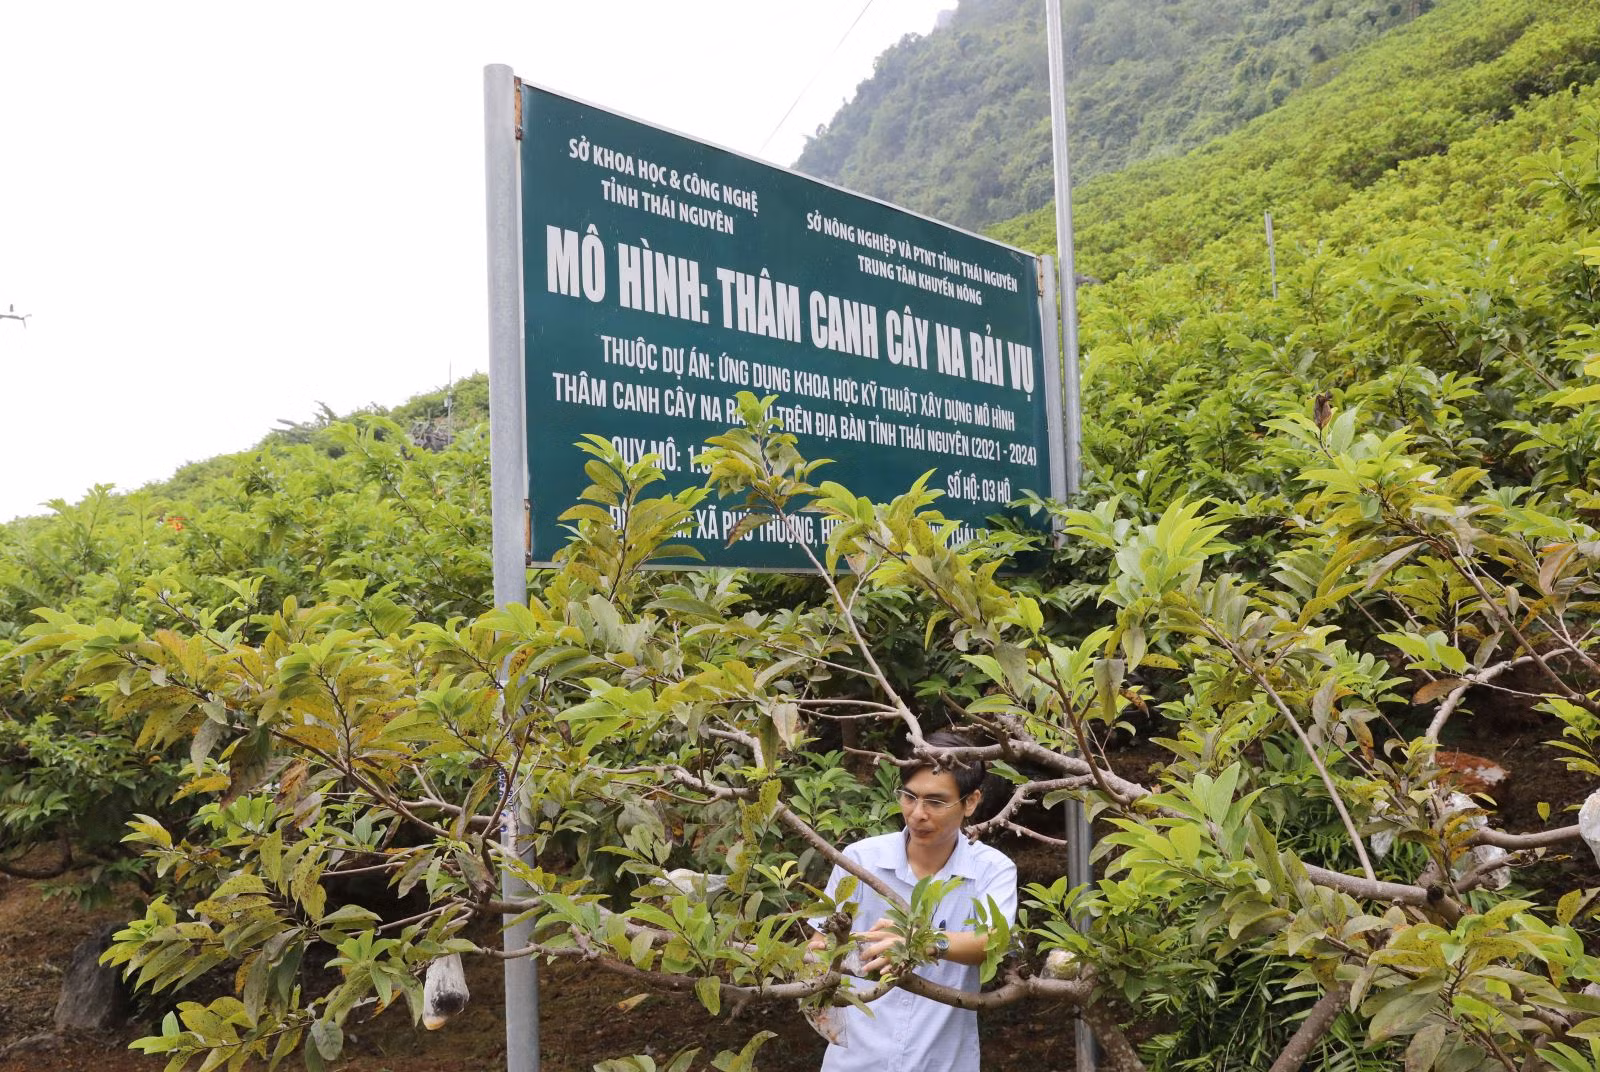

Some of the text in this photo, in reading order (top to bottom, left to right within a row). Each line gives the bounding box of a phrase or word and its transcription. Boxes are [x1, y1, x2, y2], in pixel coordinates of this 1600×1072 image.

[569, 135, 759, 217] SỞ KHOA HỌC & CÔNG NGHỆ
[601, 176, 734, 235] TỈNH THÁI NGUYÊN
[807, 209, 1018, 293] SỞ NÔNG NGHIỆP VÀ PTNT TỈNH THÁI NGUYÊN
[858, 254, 982, 306] TRUNG TÂM KHUYẾN NÔNG
[546, 224, 1035, 402] MÔ HÌNH: THÂM CANH CÂY NA RẢI VỤ
[552, 372, 607, 408] THÂM
[612, 381, 660, 415] CANH
[664, 385, 697, 419] CÂY
[700, 394, 723, 423] NA
[777, 404, 813, 435] TRÊN
[815, 411, 838, 443] ĐỊA
[840, 415, 866, 443] BÀN
[869, 414, 897, 447] TỈNH
[898, 422, 926, 451] THÁI
[927, 429, 970, 458] NGUYÊN
[971, 437, 1001, 462] (2021
[1010, 444, 1037, 467] 2024)
[601, 335, 1016, 432] THUỘC DỰ ÁN: ỨNG DỤNG KHOA HỌC KỸ THUẬT XÂY DỰNG MÔ HÌNH
[695, 504, 719, 540] XÃ
[947, 469, 962, 499] SỐ
[963, 473, 980, 504] HỘ:
[982, 479, 998, 502] 03
